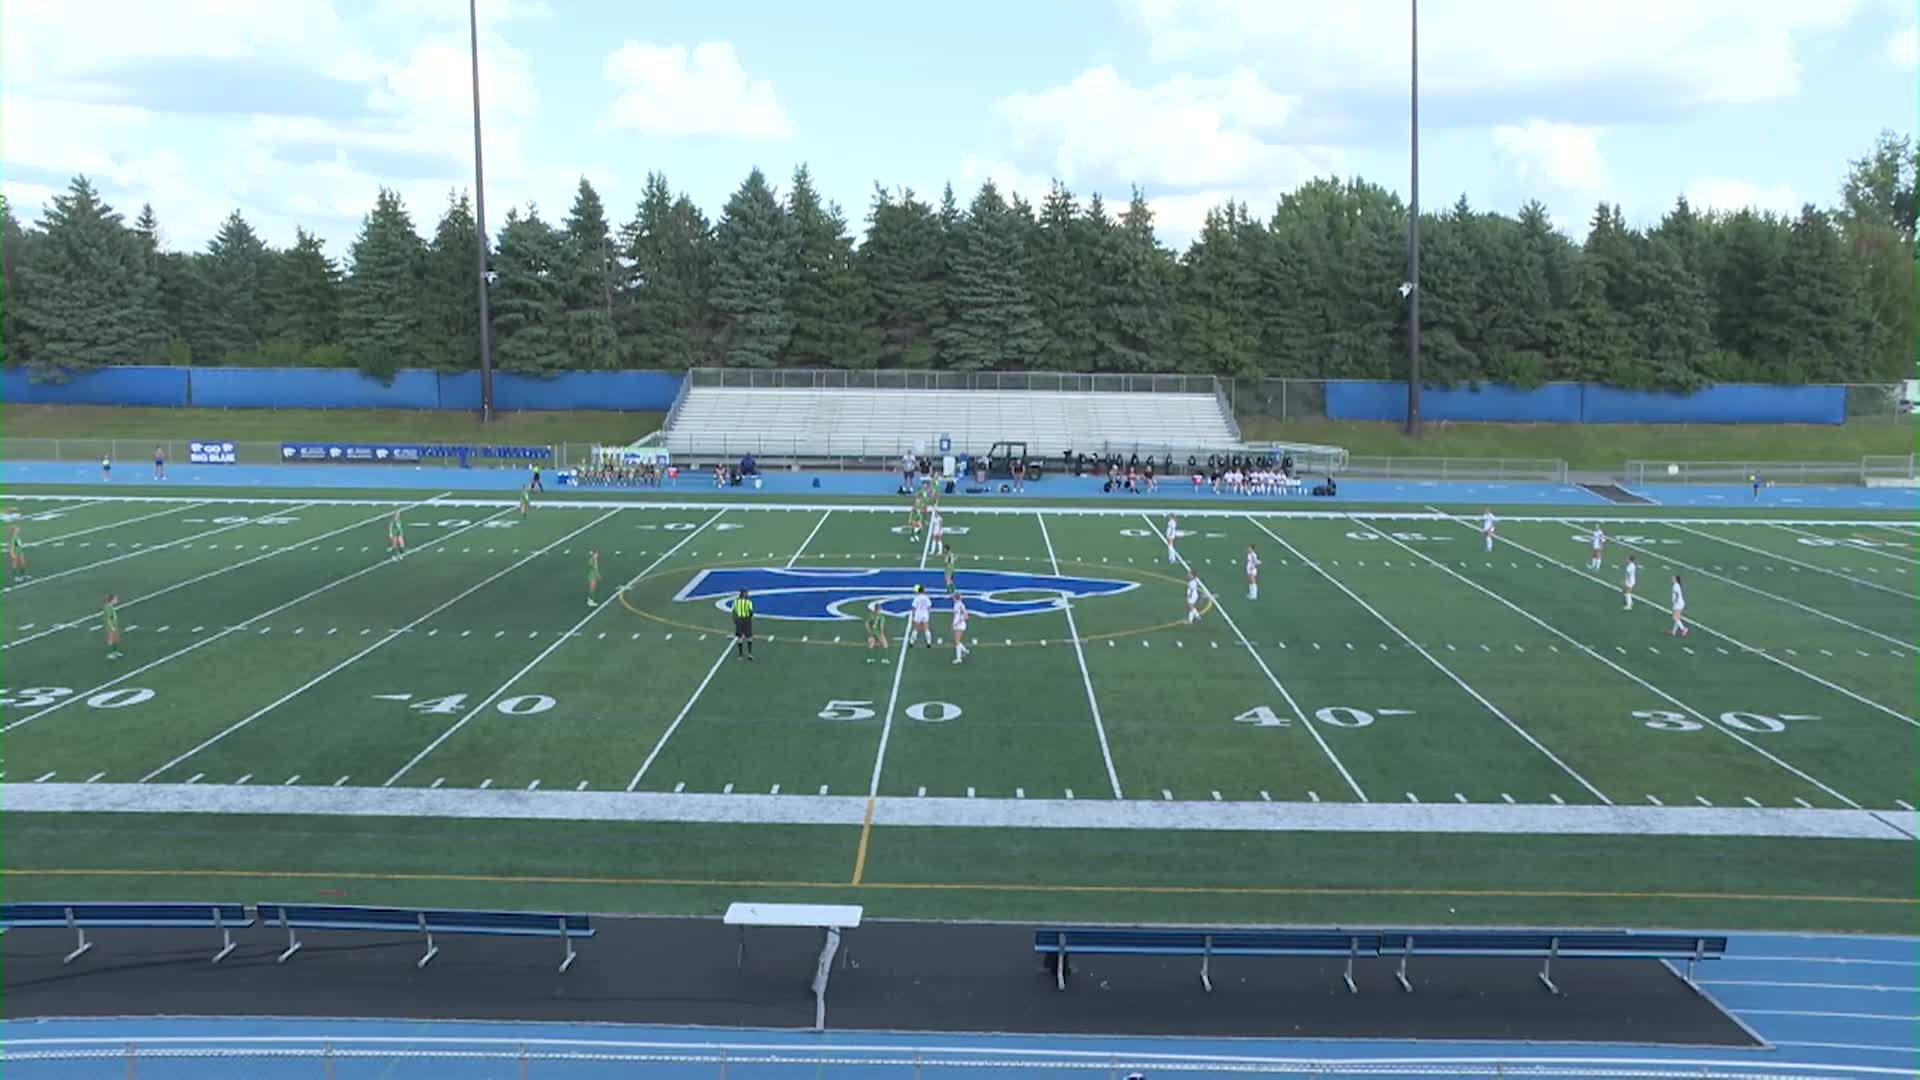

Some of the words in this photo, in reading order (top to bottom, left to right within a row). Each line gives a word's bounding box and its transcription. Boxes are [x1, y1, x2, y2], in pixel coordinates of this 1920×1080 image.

[204, 444, 221, 453] GO
[209, 453, 235, 462] BLUE
[410, 693, 557, 715] 40
[818, 700, 963, 722] 50
[1234, 705, 1376, 728] 40
[1632, 710, 1786, 733] 30
